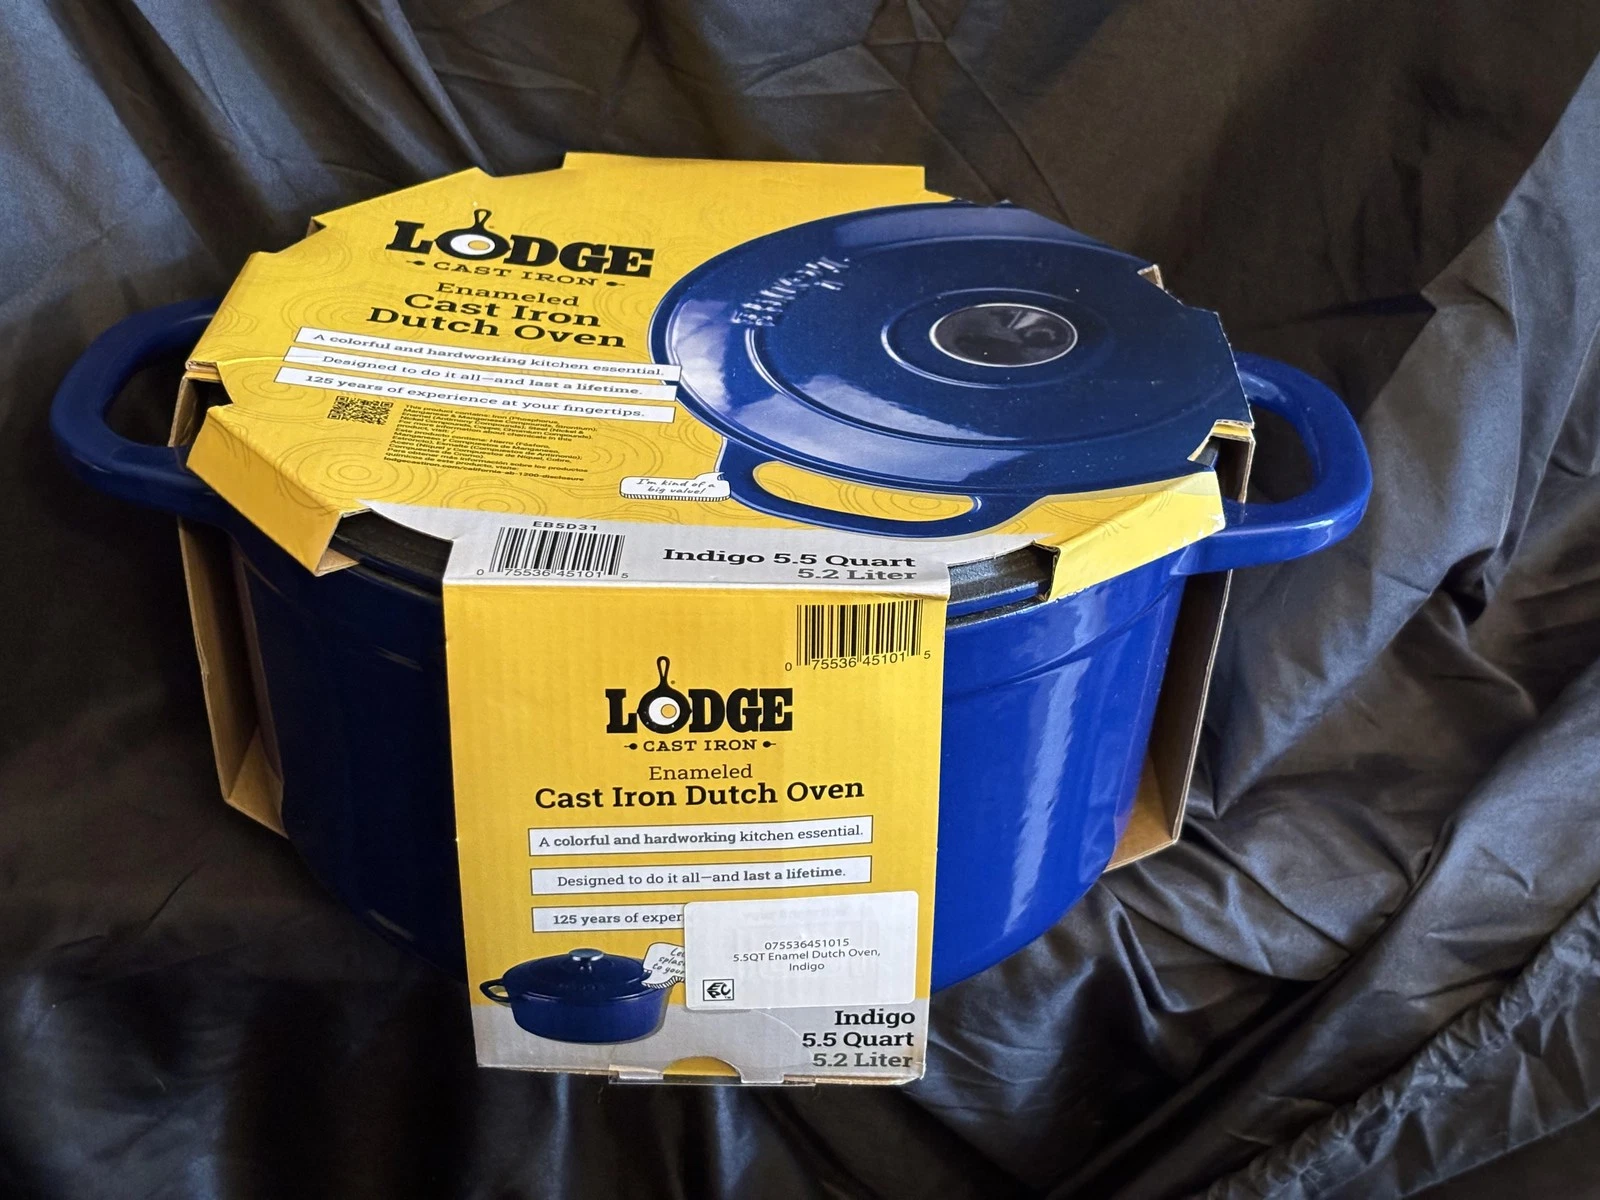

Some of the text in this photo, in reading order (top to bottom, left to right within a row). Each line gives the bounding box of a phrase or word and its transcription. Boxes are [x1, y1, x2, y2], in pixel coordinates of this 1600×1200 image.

[385, 209, 655, 278] LODGE
[434, 262, 598, 286] CAST IRON
[437, 282, 579, 306] Enameled
[405, 293, 600, 326] Cast Iron
[366, 307, 626, 348] Dutch Oven
[330, 336, 390, 350] colorful
[394, 344, 423, 354] and
[426, 348, 526, 366] hardworking
[530, 358, 588, 370] kitchen
[593, 364, 664, 375] essential.
[322, 355, 397, 372] Designed
[402, 366, 417, 374] to
[421, 367, 441, 377] do
[444, 370, 456, 379] it
[529, 379, 559, 388] last
[576, 383, 642, 395] lifetime.
[305, 375, 644, 417] 125 years of experience at your fingertips.
[533, 521, 598, 531] EB5D31
[663, 549, 916, 567] Indigo 5.5 Quart
[505, 569, 550, 577] 75536
[557, 570, 601, 578] 45101
[798, 568, 917, 580] 5.2 Liter
[784, 650, 931, 672] 0 75536 45101 5
[605, 656, 793, 734] LODGE
[643, 739, 757, 752] CAST IRON
[649, 764, 753, 781] Enameled
[535, 781, 864, 809] Cast Iron Dutch Oven
[539, 825, 863, 847] A colorful and hardworking kitchen essential.
[558, 874, 625, 888] Designed
[628, 875, 642, 885] to
[646, 873, 664, 884] do
[667, 873, 678, 884] it
[743, 870, 771, 881] last
[774, 872, 782, 881] a
[786, 866, 846, 880] lifetime.
[553, 912, 683, 927] 125 years of exper
[764, 938, 849, 950] 075536451015
[733, 948, 880, 962] 5.5QT Enamel Dutch Oven,
[789, 962, 825, 972] Indigo
[835, 1010, 915, 1027] Indigo
[802, 1032, 914, 1047] 5.5 Quart
[812, 1053, 913, 1067] 5.2 Liter
